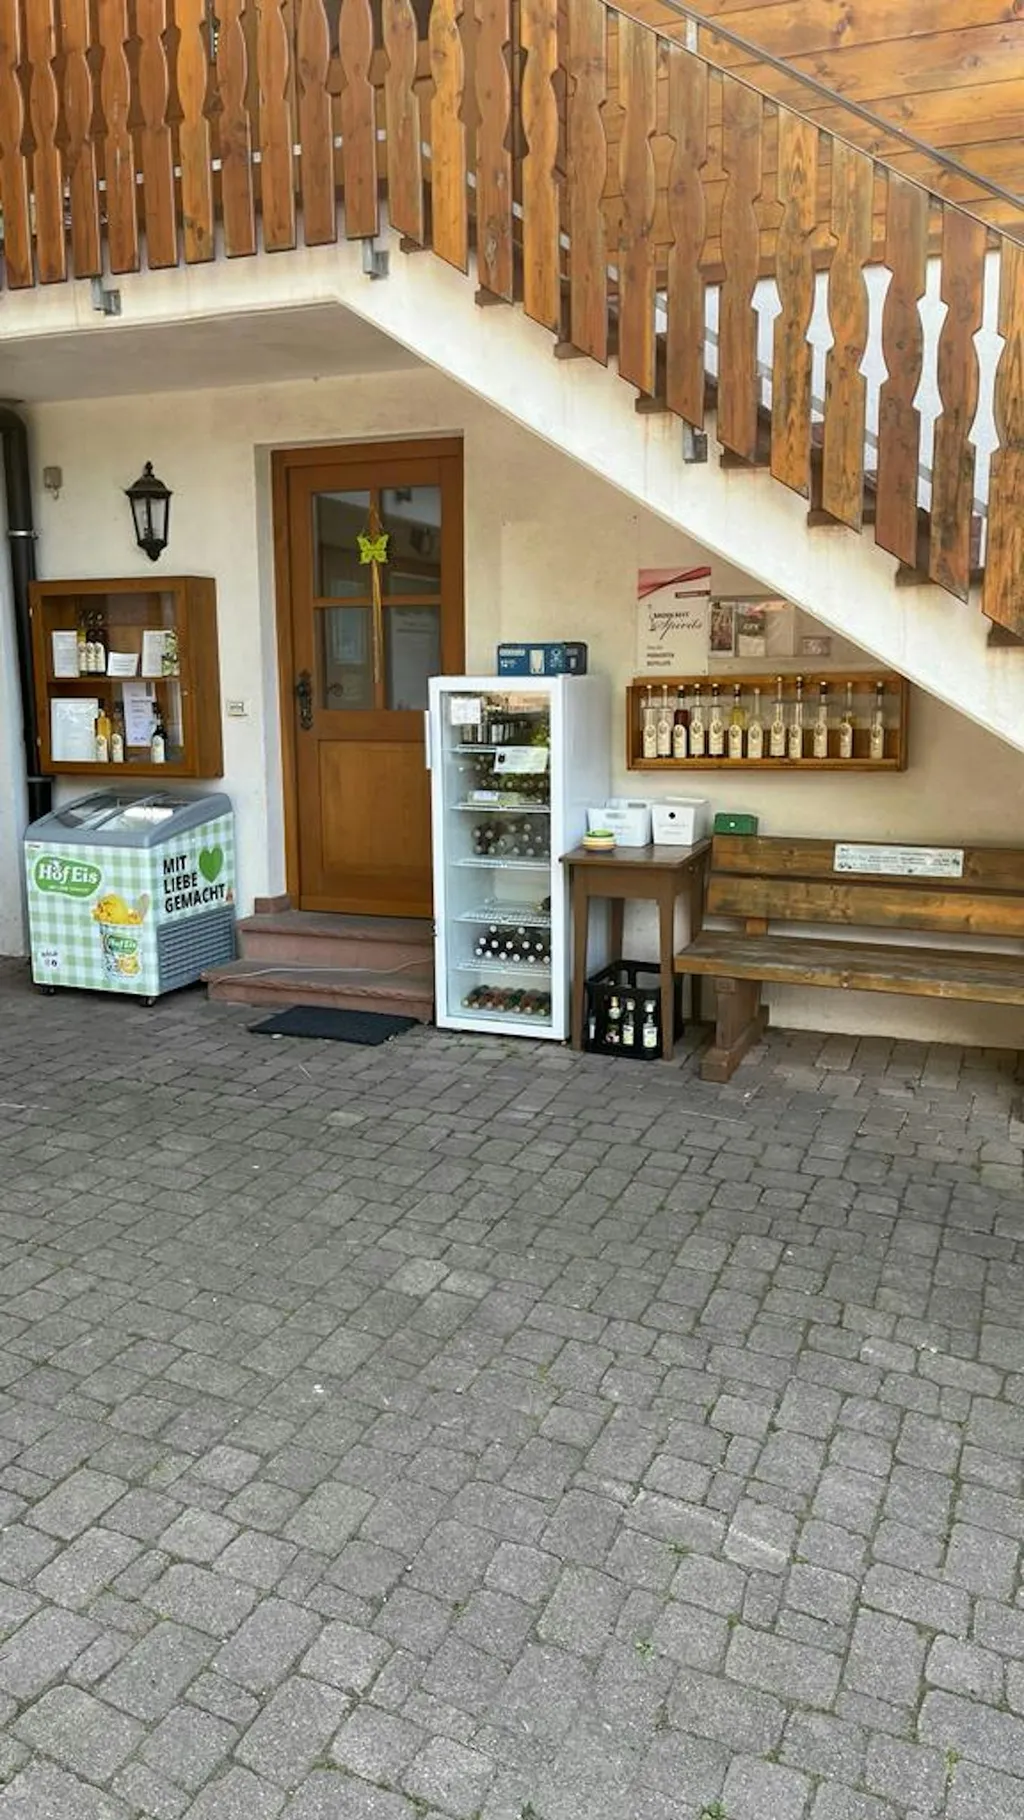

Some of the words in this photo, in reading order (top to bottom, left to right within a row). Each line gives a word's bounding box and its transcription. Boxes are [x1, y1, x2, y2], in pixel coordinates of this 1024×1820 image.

[38, 862, 69, 884] Hof
[71, 866, 98, 884] Eis
[163, 855, 187, 874] MIT
[163, 872, 197, 894] LIEBE
[165, 883, 225, 913] GEMACHT
